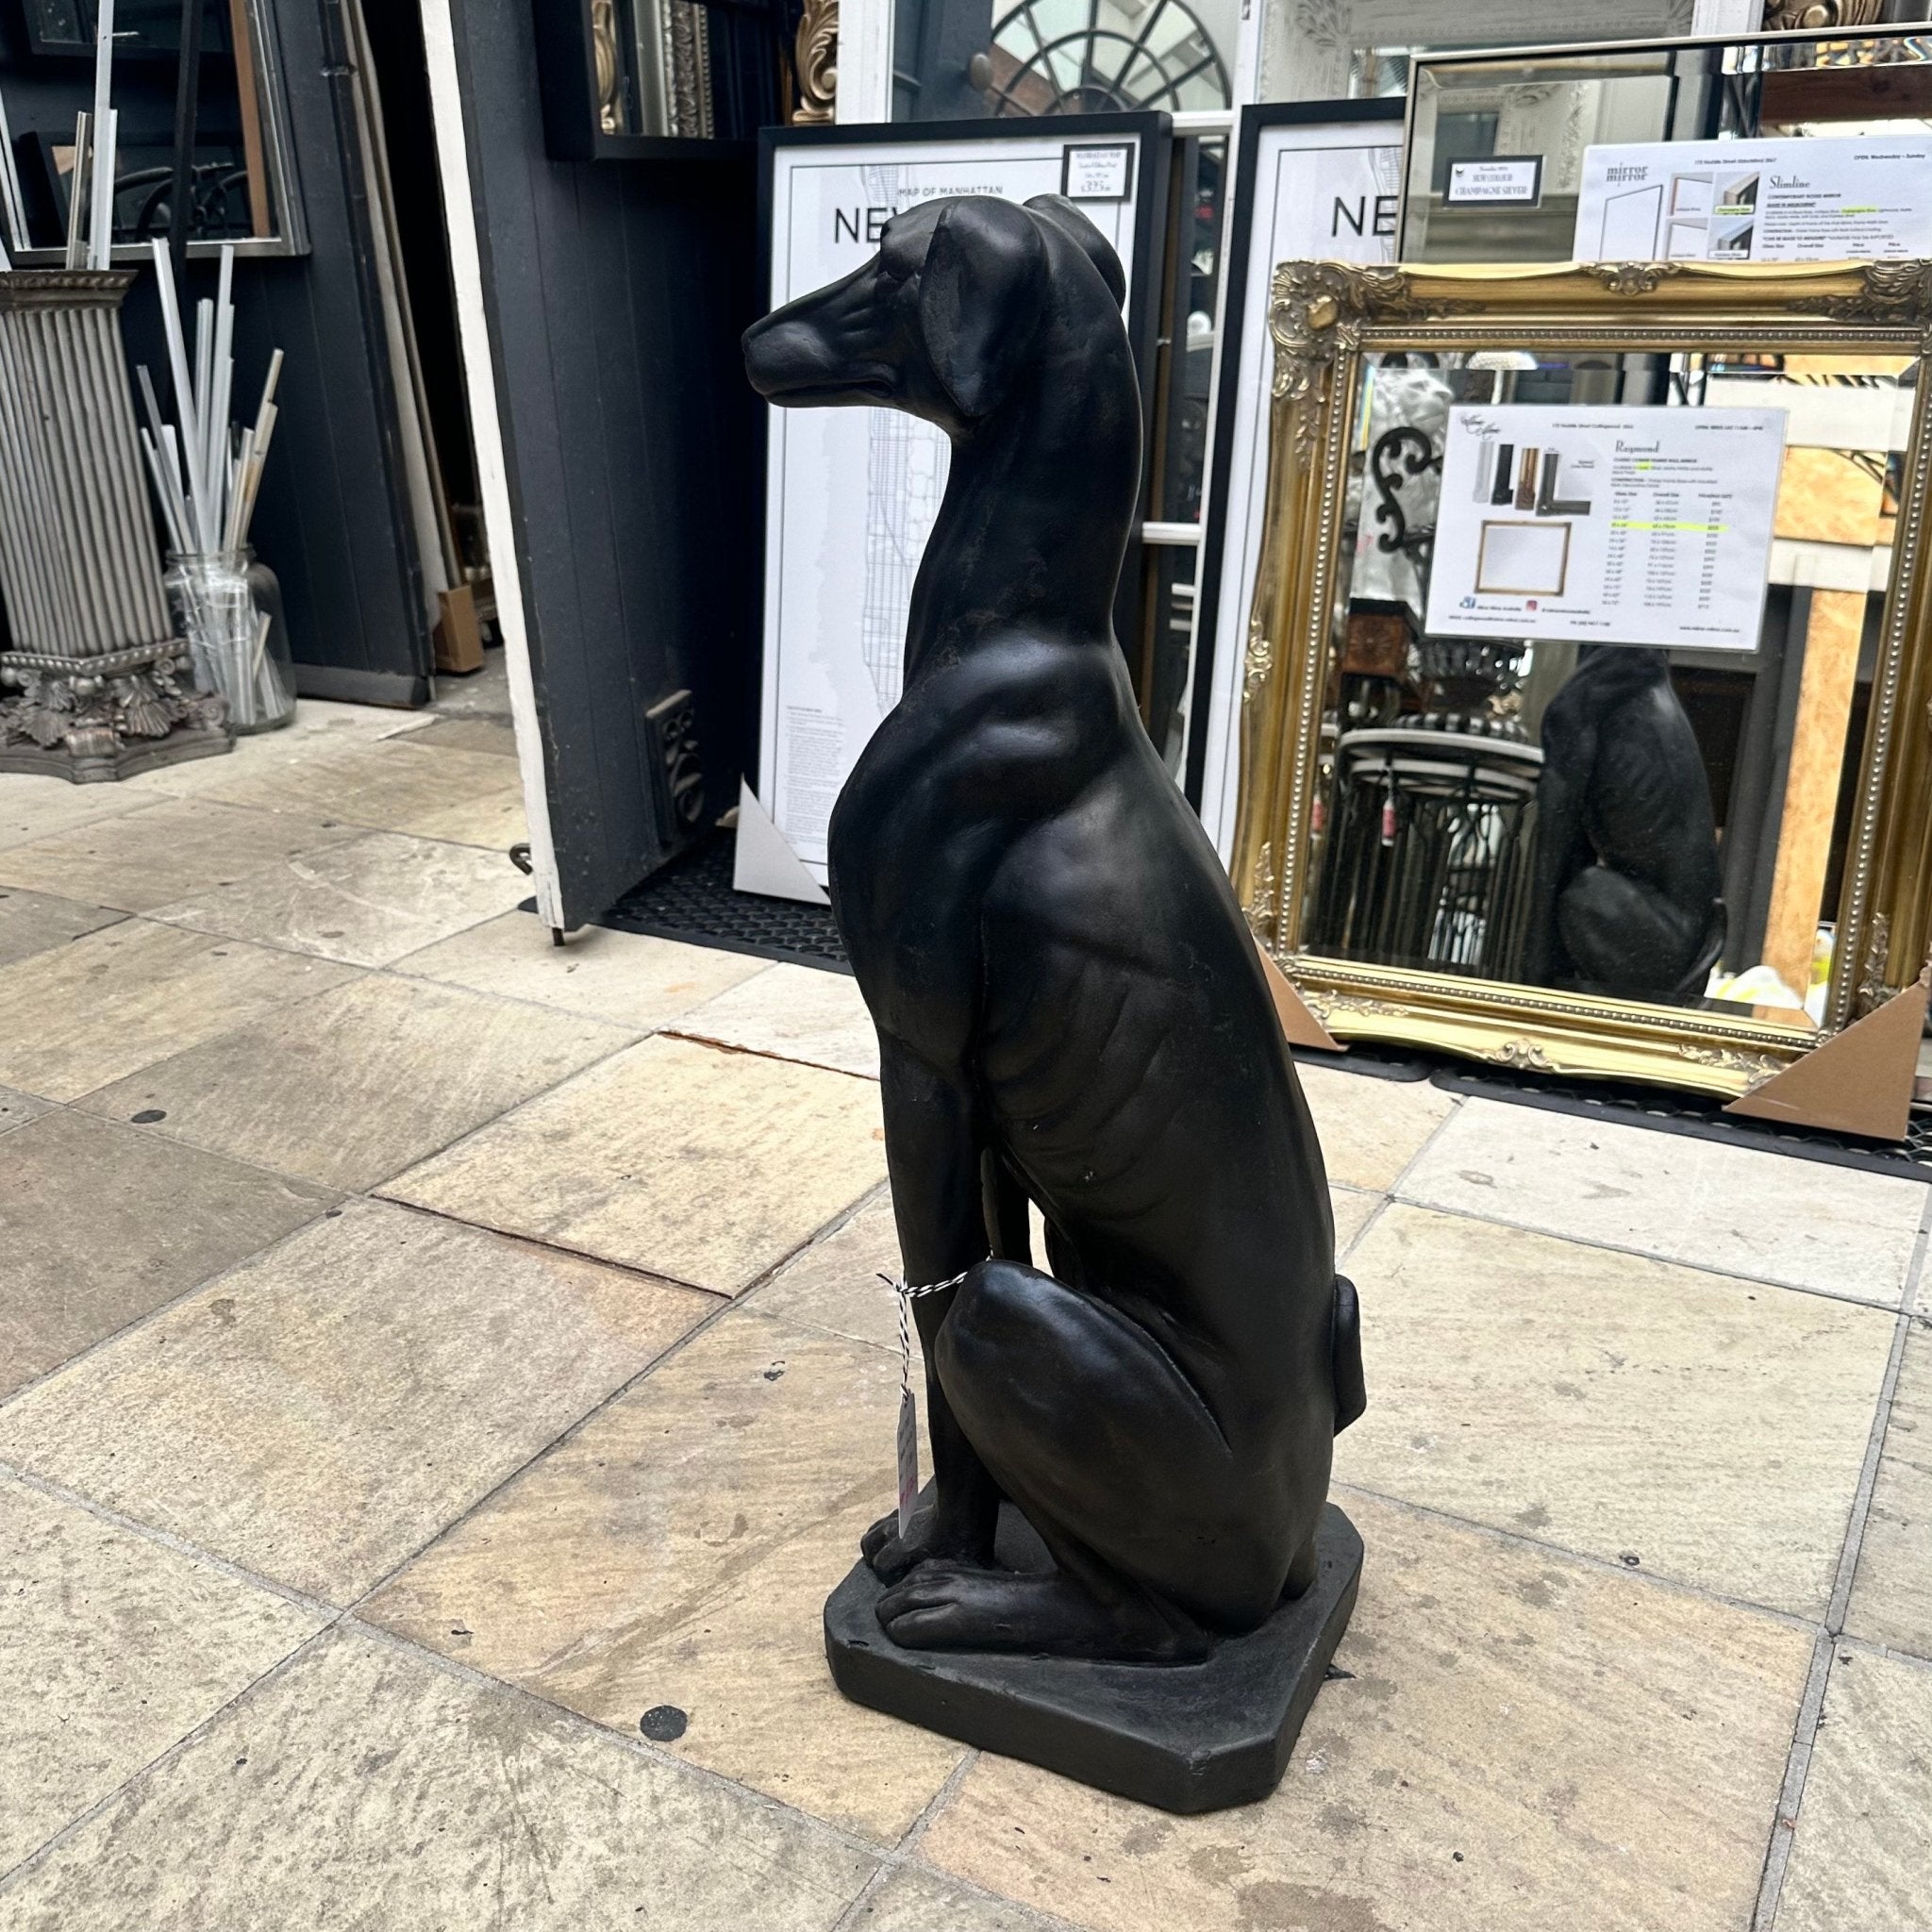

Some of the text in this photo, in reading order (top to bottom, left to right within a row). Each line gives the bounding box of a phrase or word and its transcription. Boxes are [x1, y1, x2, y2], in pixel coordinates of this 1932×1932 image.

[1607, 162, 1649, 175] mirror
[1606, 174, 1648, 187] mirror
[1769, 175, 1811, 189] Slimline
[898, 185, 1004, 197] MAP OF MANHATTAN
[834, 206, 899, 244] NE
[1615, 440, 1660, 454] Raymond
